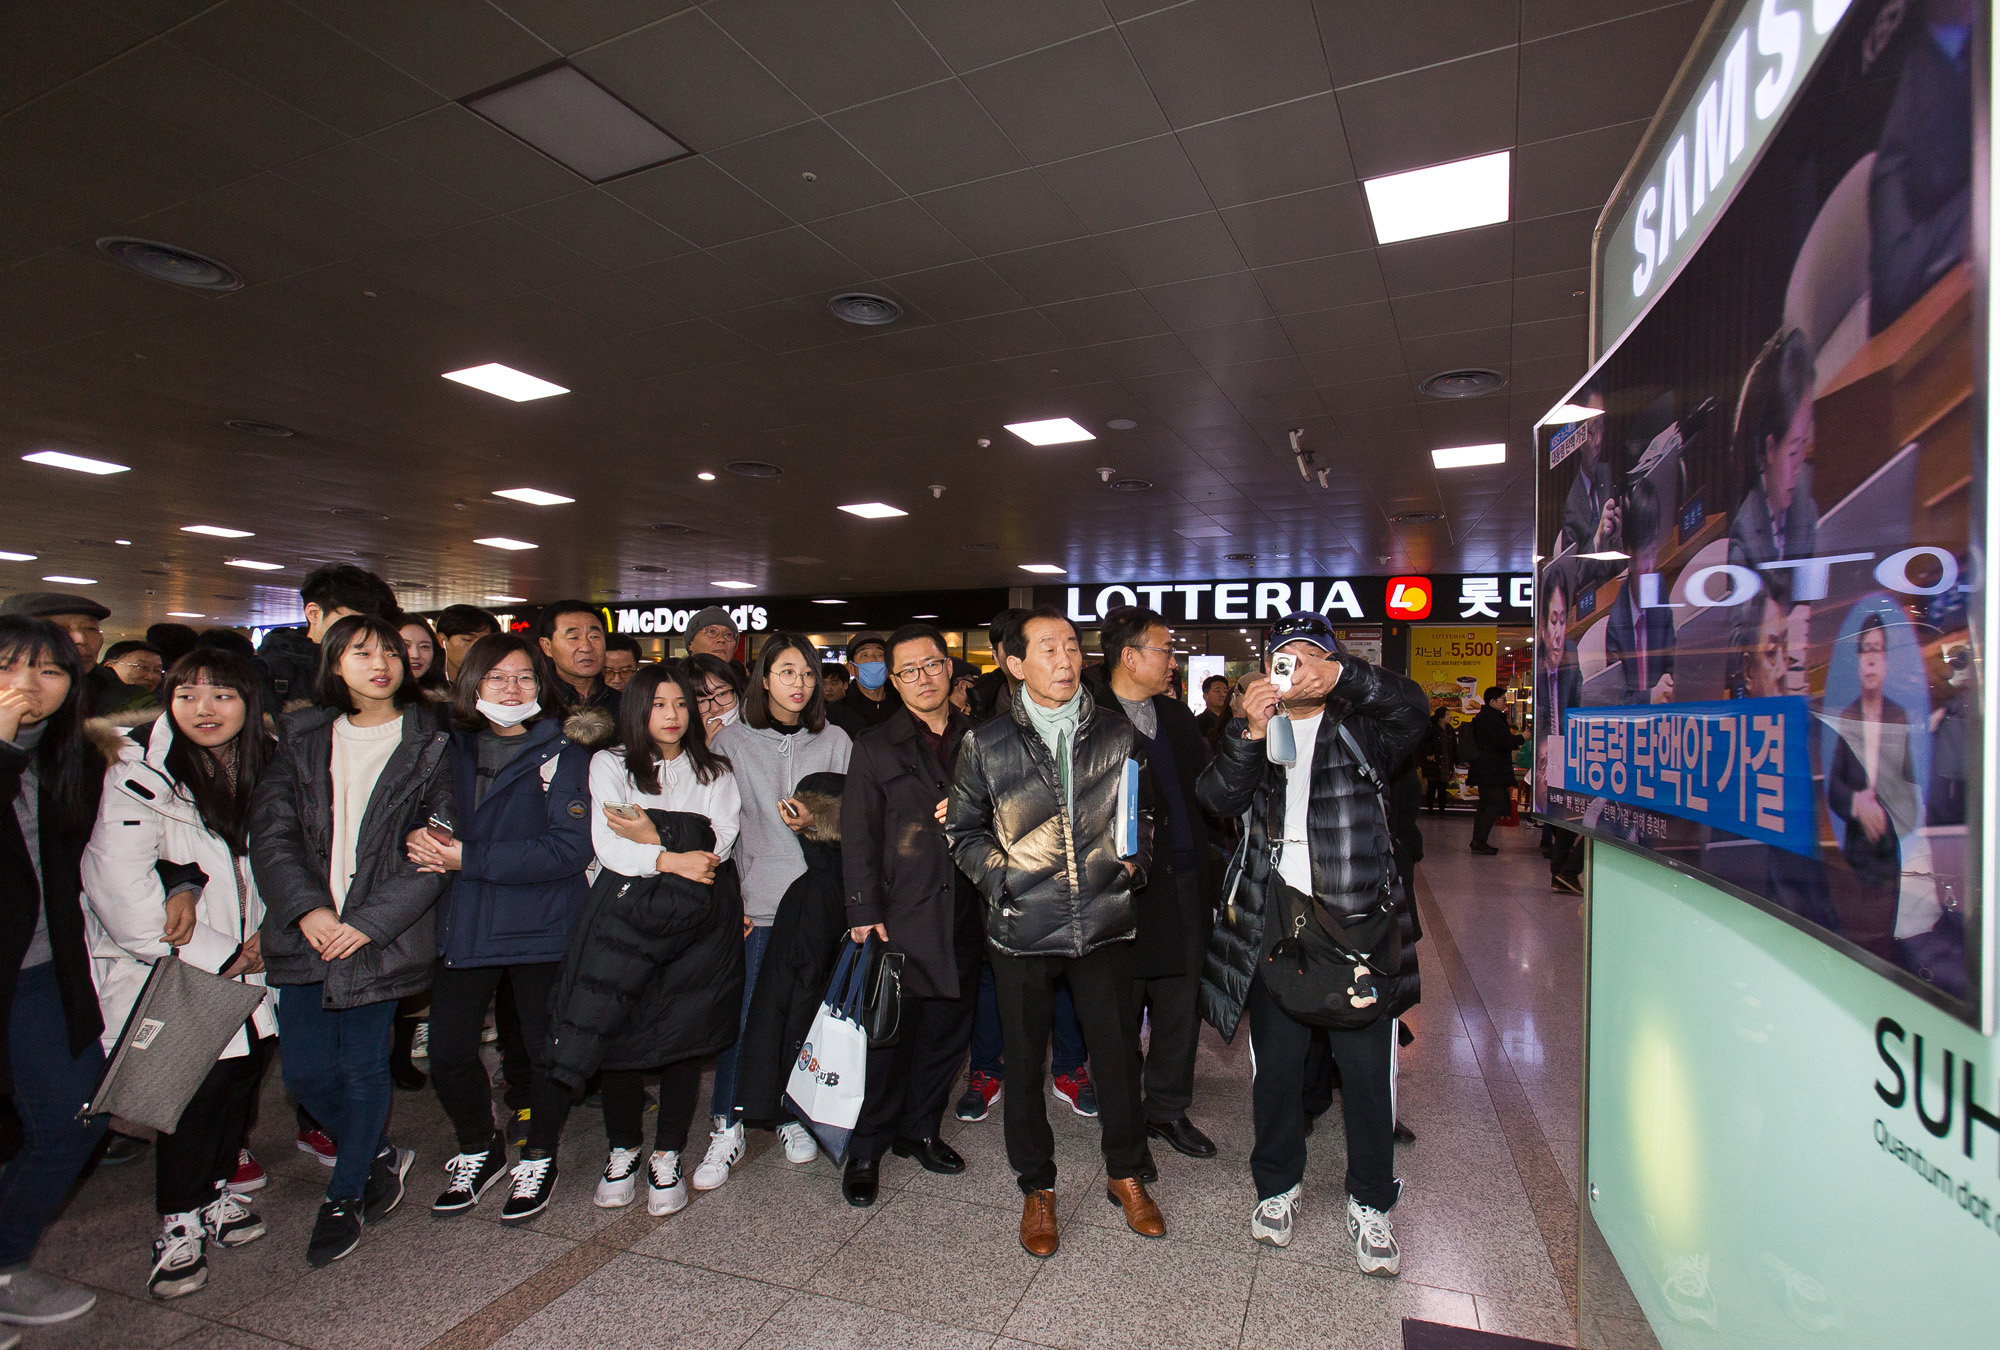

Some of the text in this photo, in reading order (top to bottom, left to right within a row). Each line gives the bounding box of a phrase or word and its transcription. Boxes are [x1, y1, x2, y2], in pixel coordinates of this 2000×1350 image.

[1067, 581, 1364, 622] LOTTERIA
[1415, 646, 1442, 658] 치느님
[1451, 642, 1493, 659] 5,500
[1567, 713, 1785, 834] 대통령 탄핵안 가결
[1646, 814, 1667, 839] 총력전
[1874, 1118, 1955, 1199] Quantum
